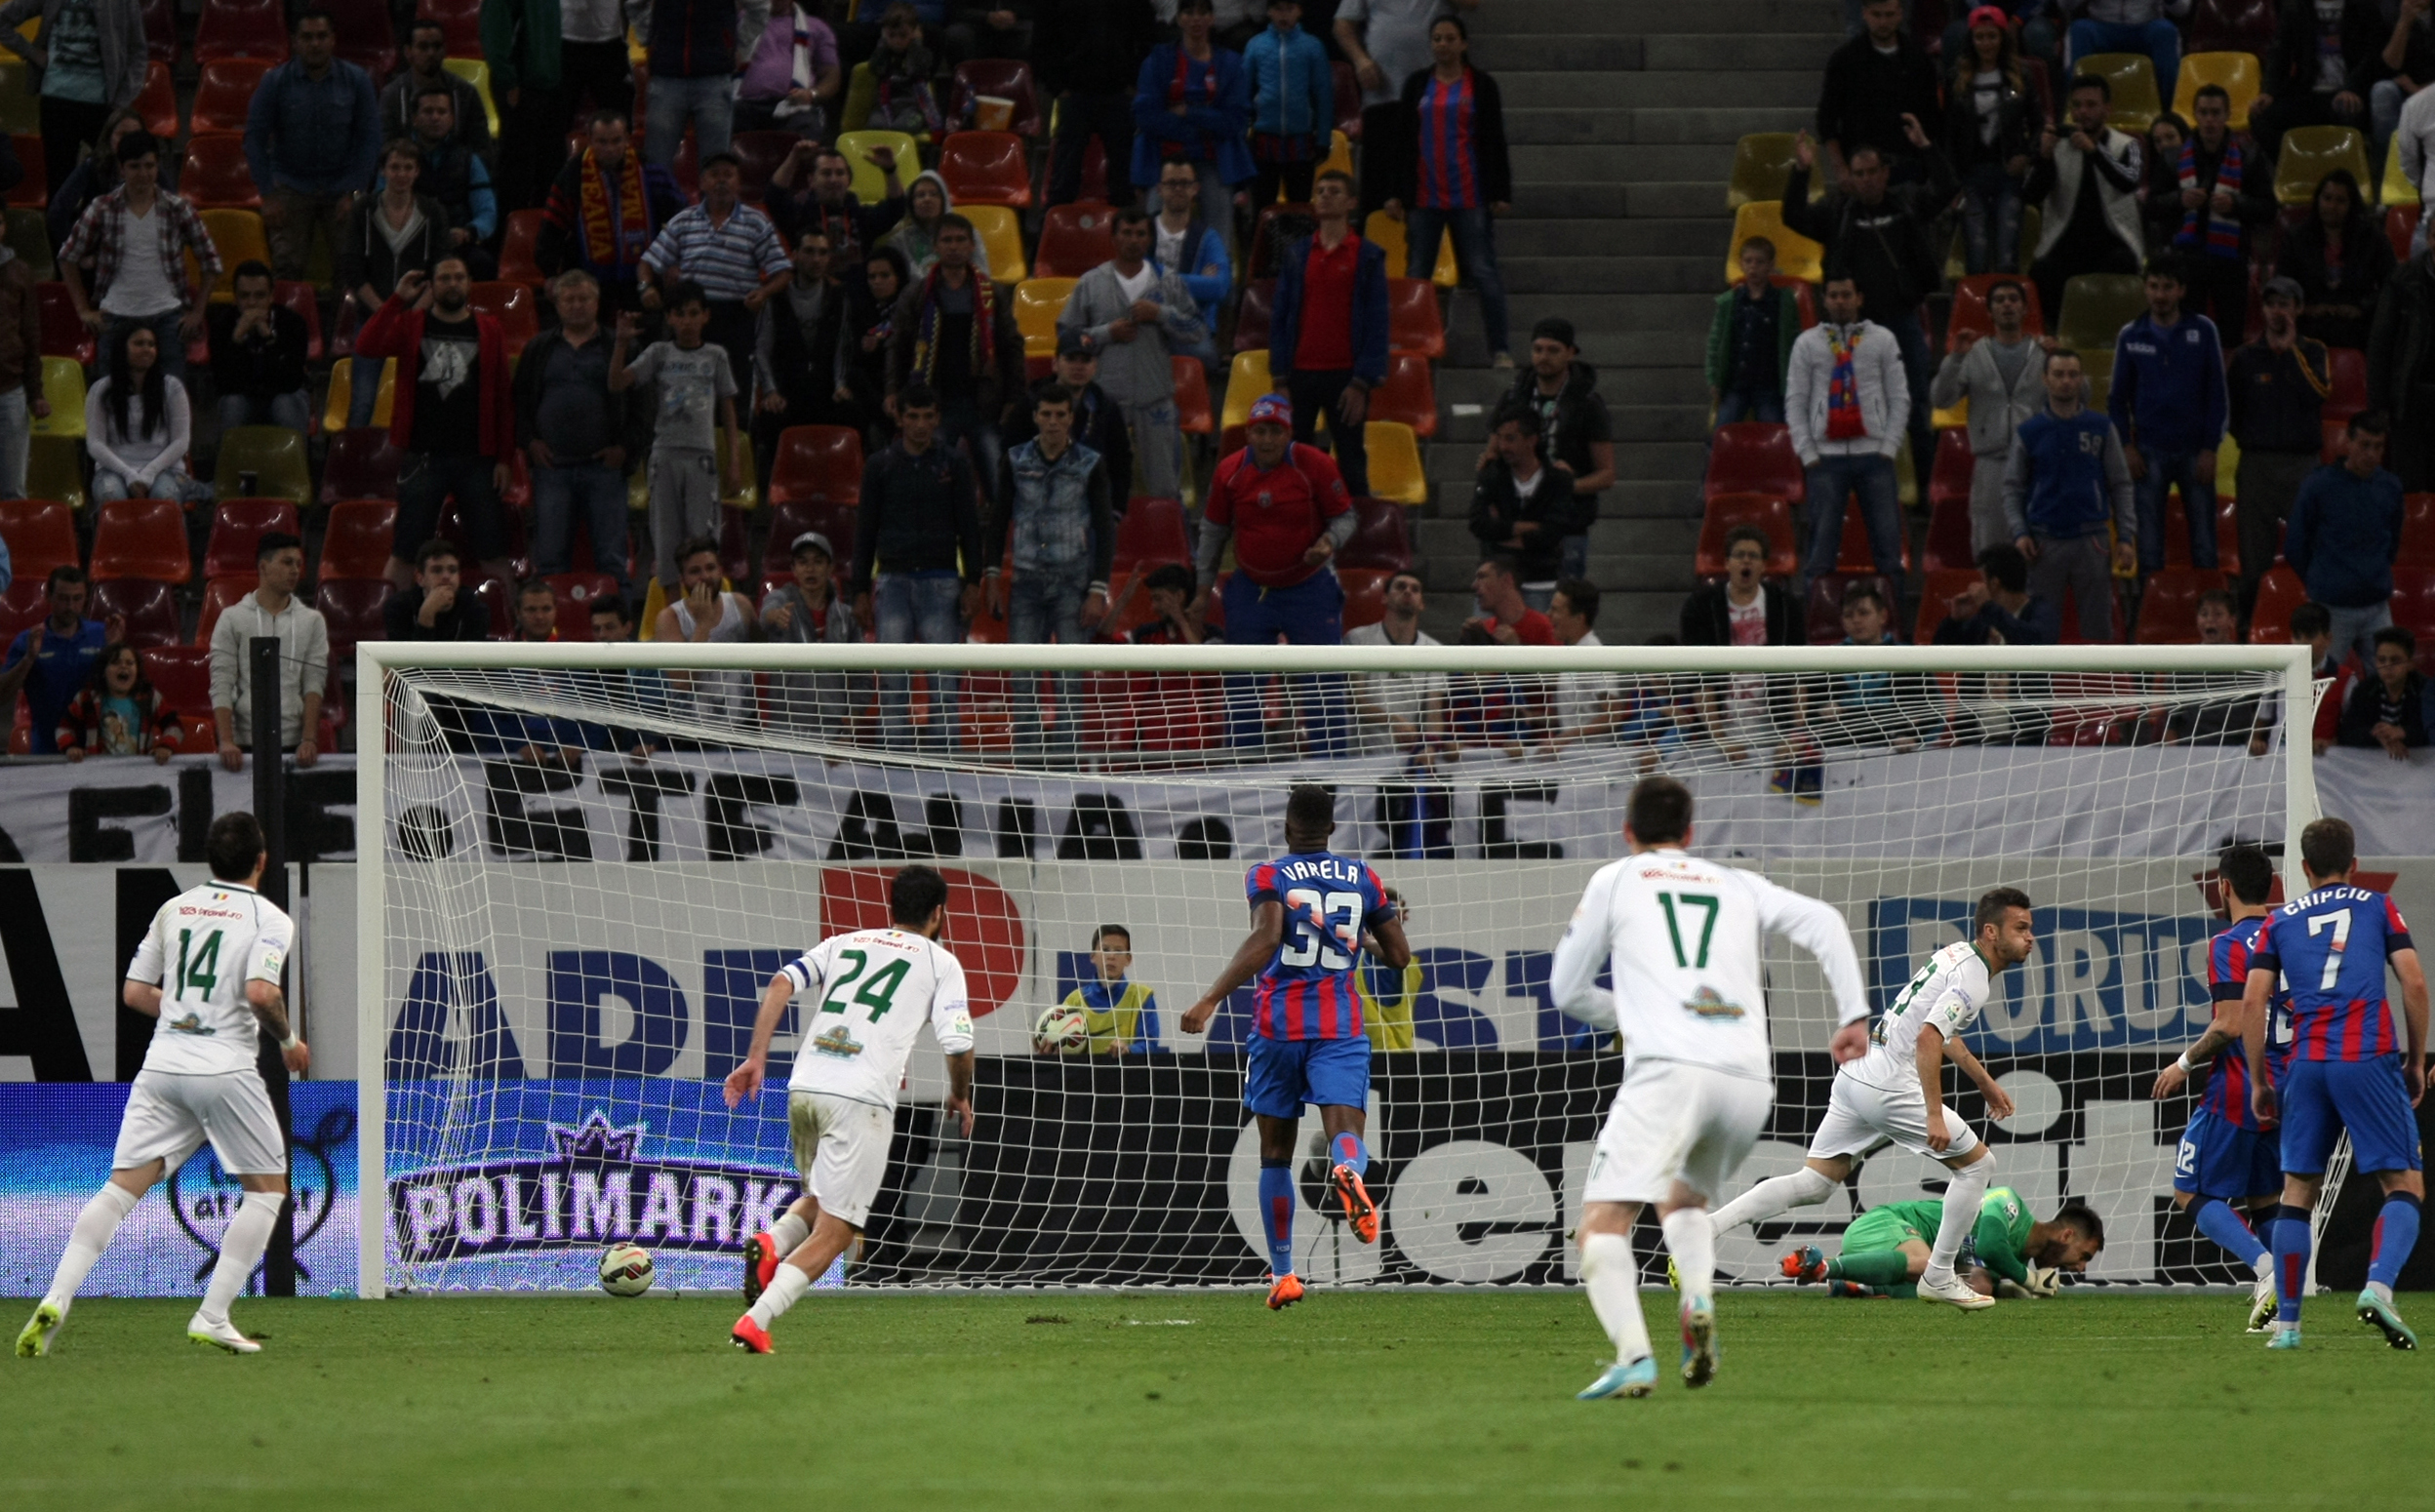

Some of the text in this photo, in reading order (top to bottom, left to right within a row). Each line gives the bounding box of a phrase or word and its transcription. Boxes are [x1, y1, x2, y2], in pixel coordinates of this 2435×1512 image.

[1281, 859, 1358, 885] VARELA
[2282, 886, 2373, 917] CHIPCIU
[175, 928, 223, 1002] 14
[1280, 888, 1363, 970] 33
[1657, 892, 1719, 969] 17
[2307, 907, 2352, 991] 7
[820, 949, 911, 1024] 24
[2176, 1137, 2196, 1174] 12
[407, 1171, 792, 1253] POLIMARK
